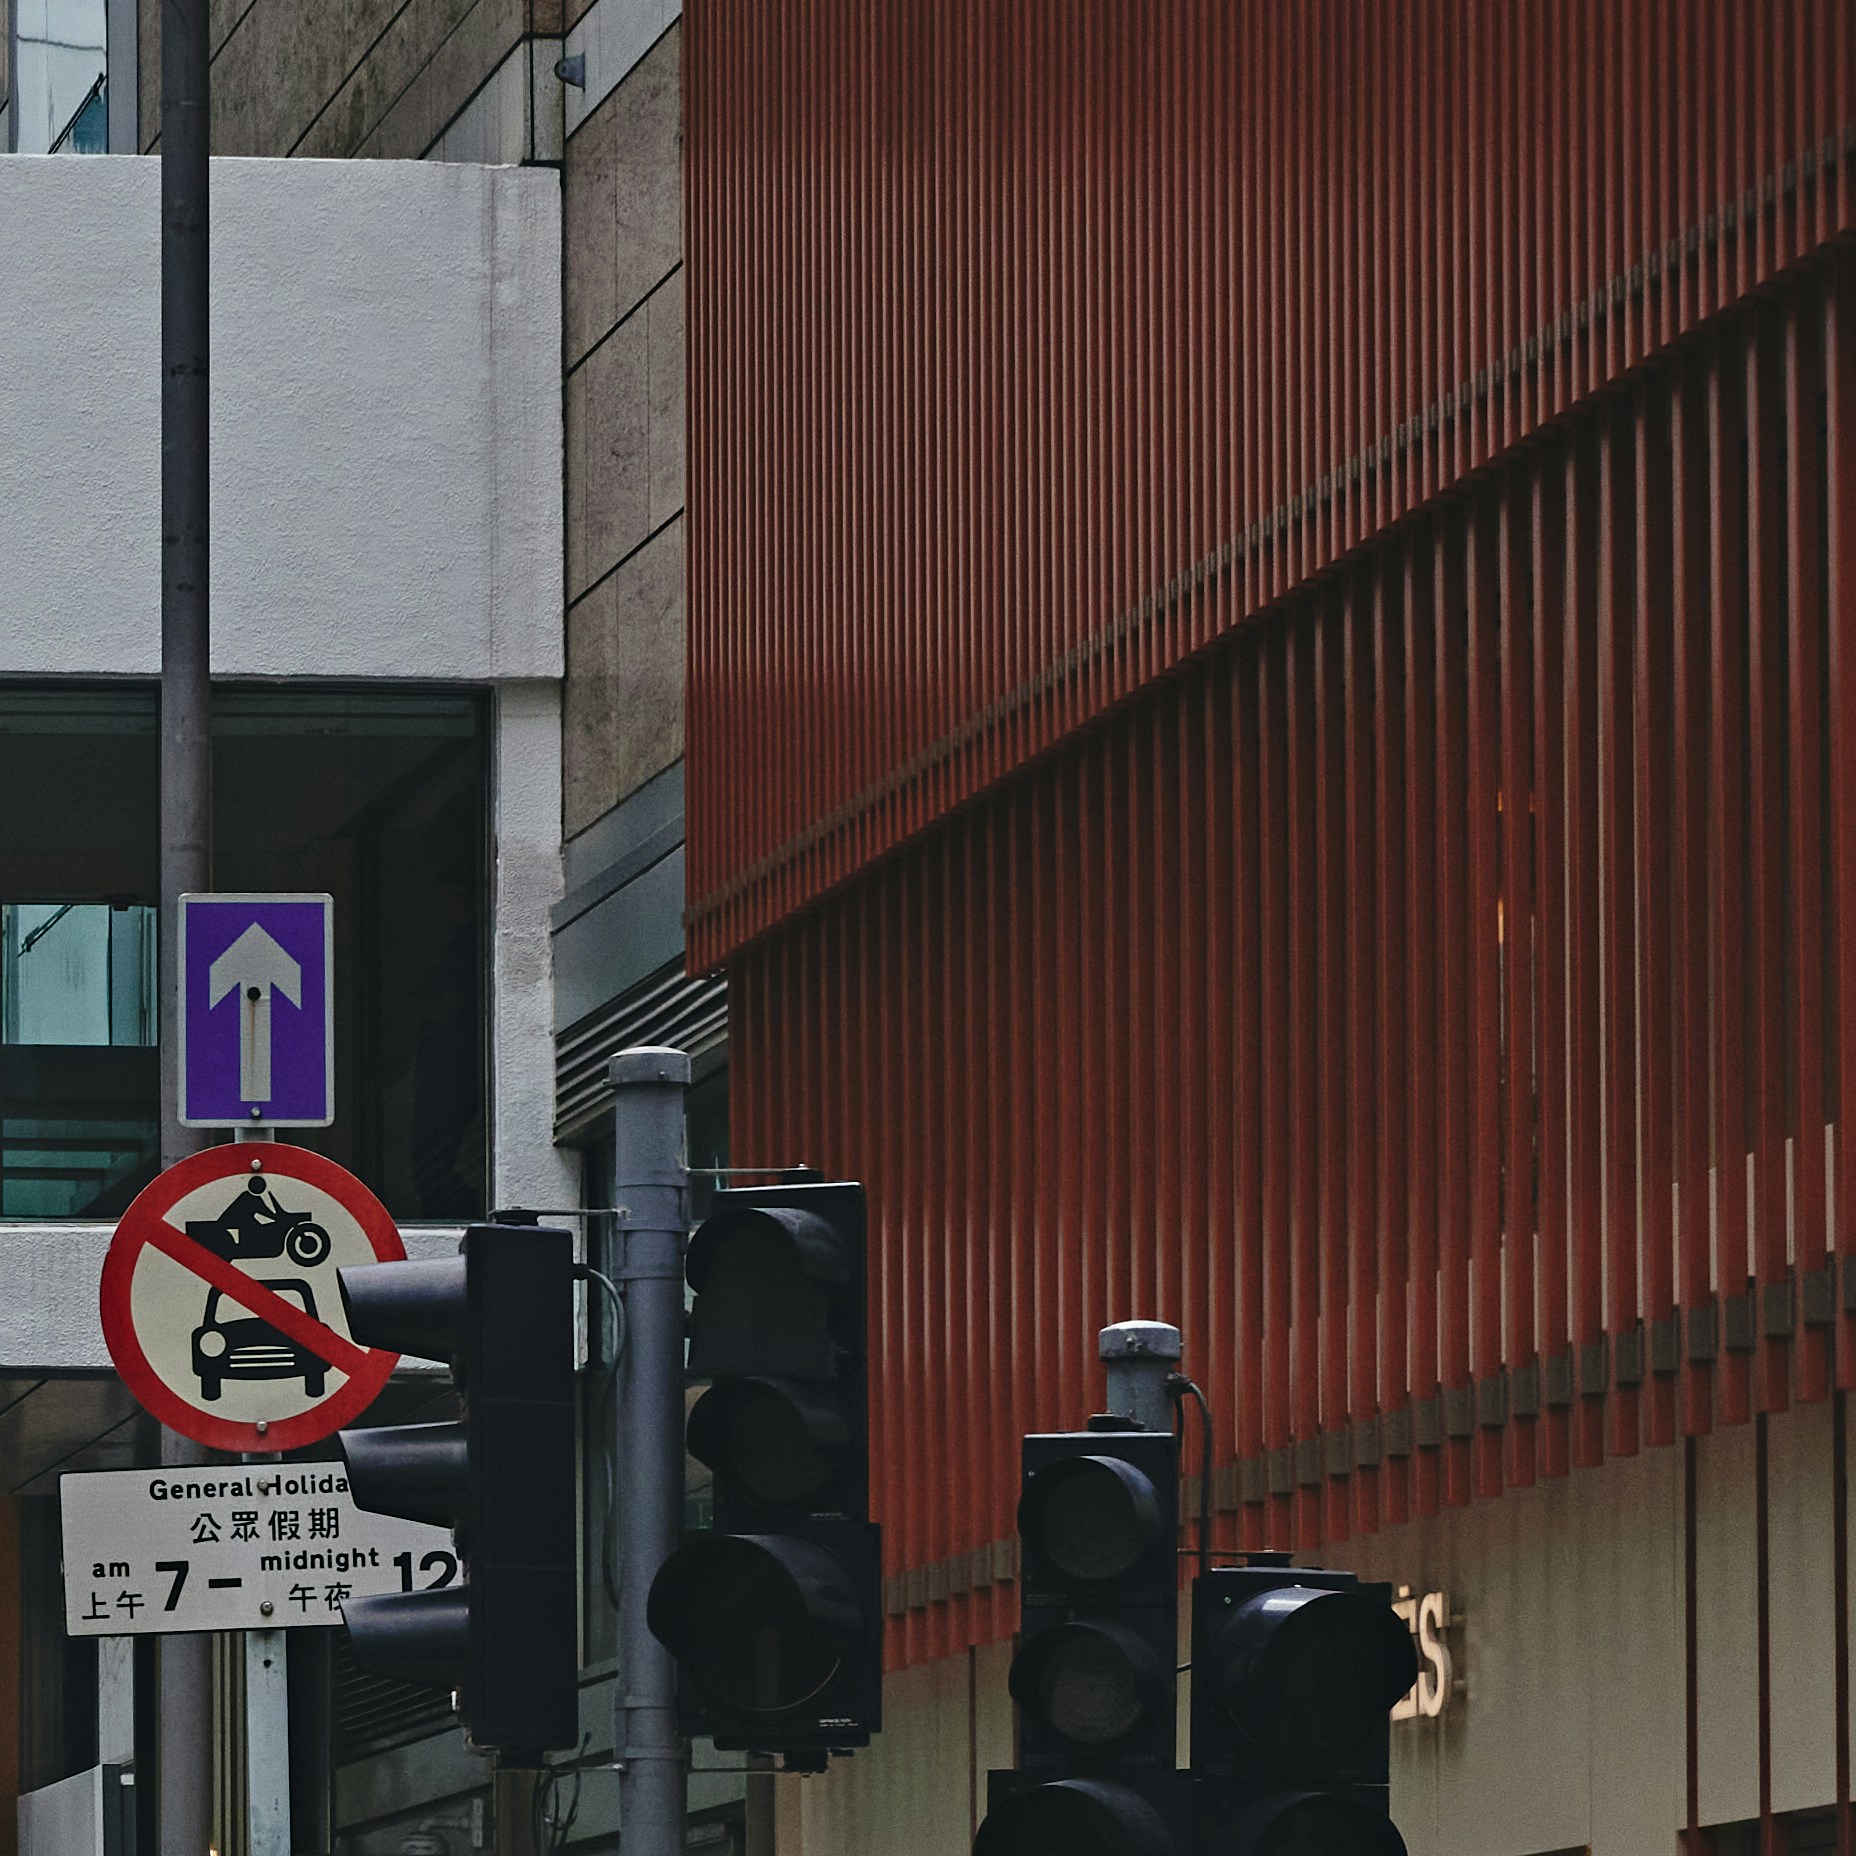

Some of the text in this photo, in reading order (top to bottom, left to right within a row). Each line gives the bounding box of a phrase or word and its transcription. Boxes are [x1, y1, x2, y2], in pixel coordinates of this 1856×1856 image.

[149, 1474, 349, 1501] General Holida
[190, 1507, 341, 1544] 公眾假期
[92, 1559, 130, 1578] am
[155, 1560, 190, 1612] 7
[261, 1547, 380, 1573] midnight
[393, 1551, 459, 1593] 12
[81, 1592, 146, 1620] 上午
